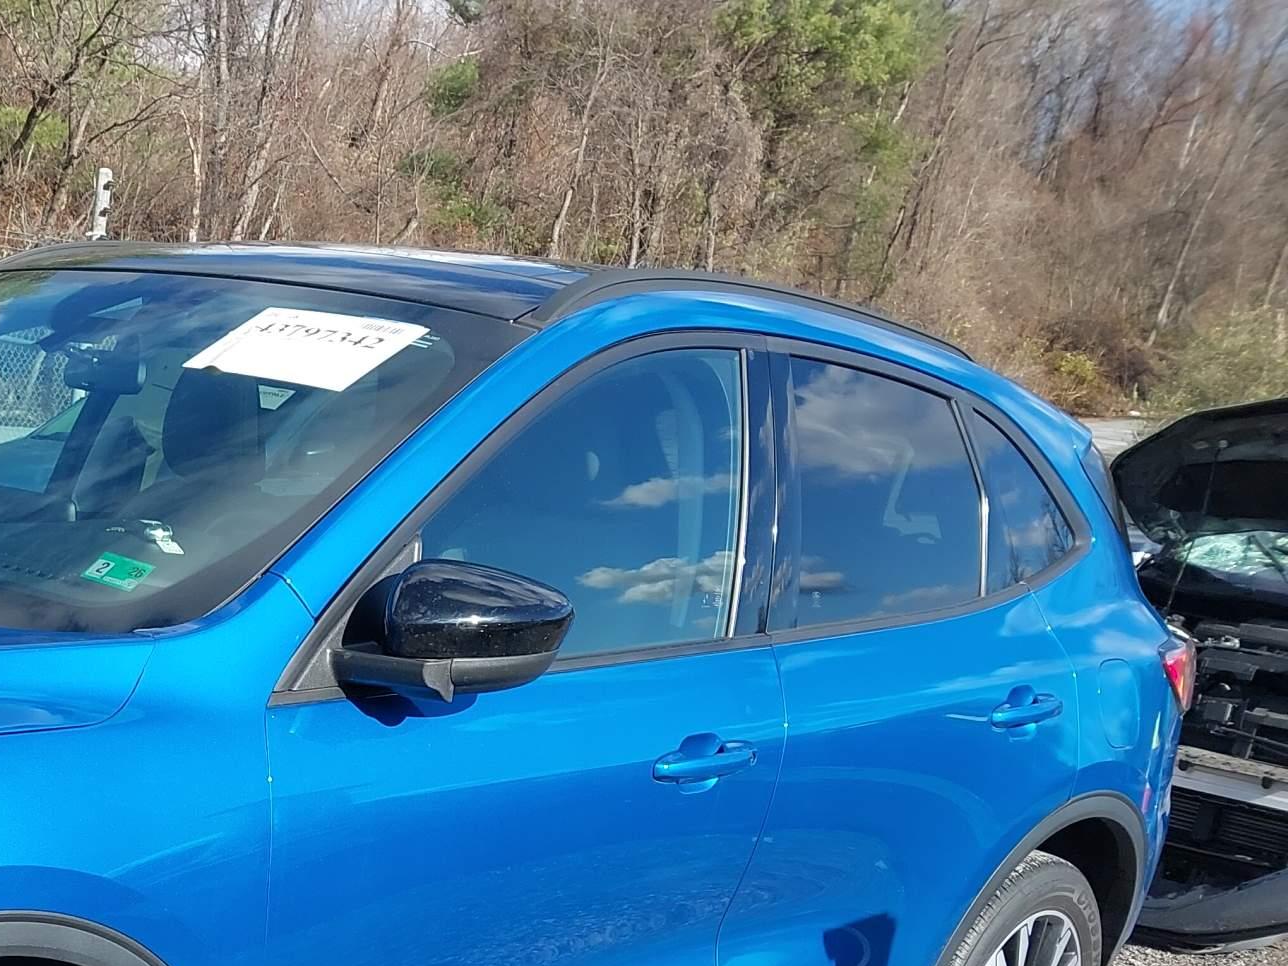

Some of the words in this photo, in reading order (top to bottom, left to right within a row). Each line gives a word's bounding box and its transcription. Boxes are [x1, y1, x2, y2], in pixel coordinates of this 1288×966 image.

[254, 321, 386, 349] 43797342
[95, 562, 110, 574] 2
[128, 566, 146, 578] 26
